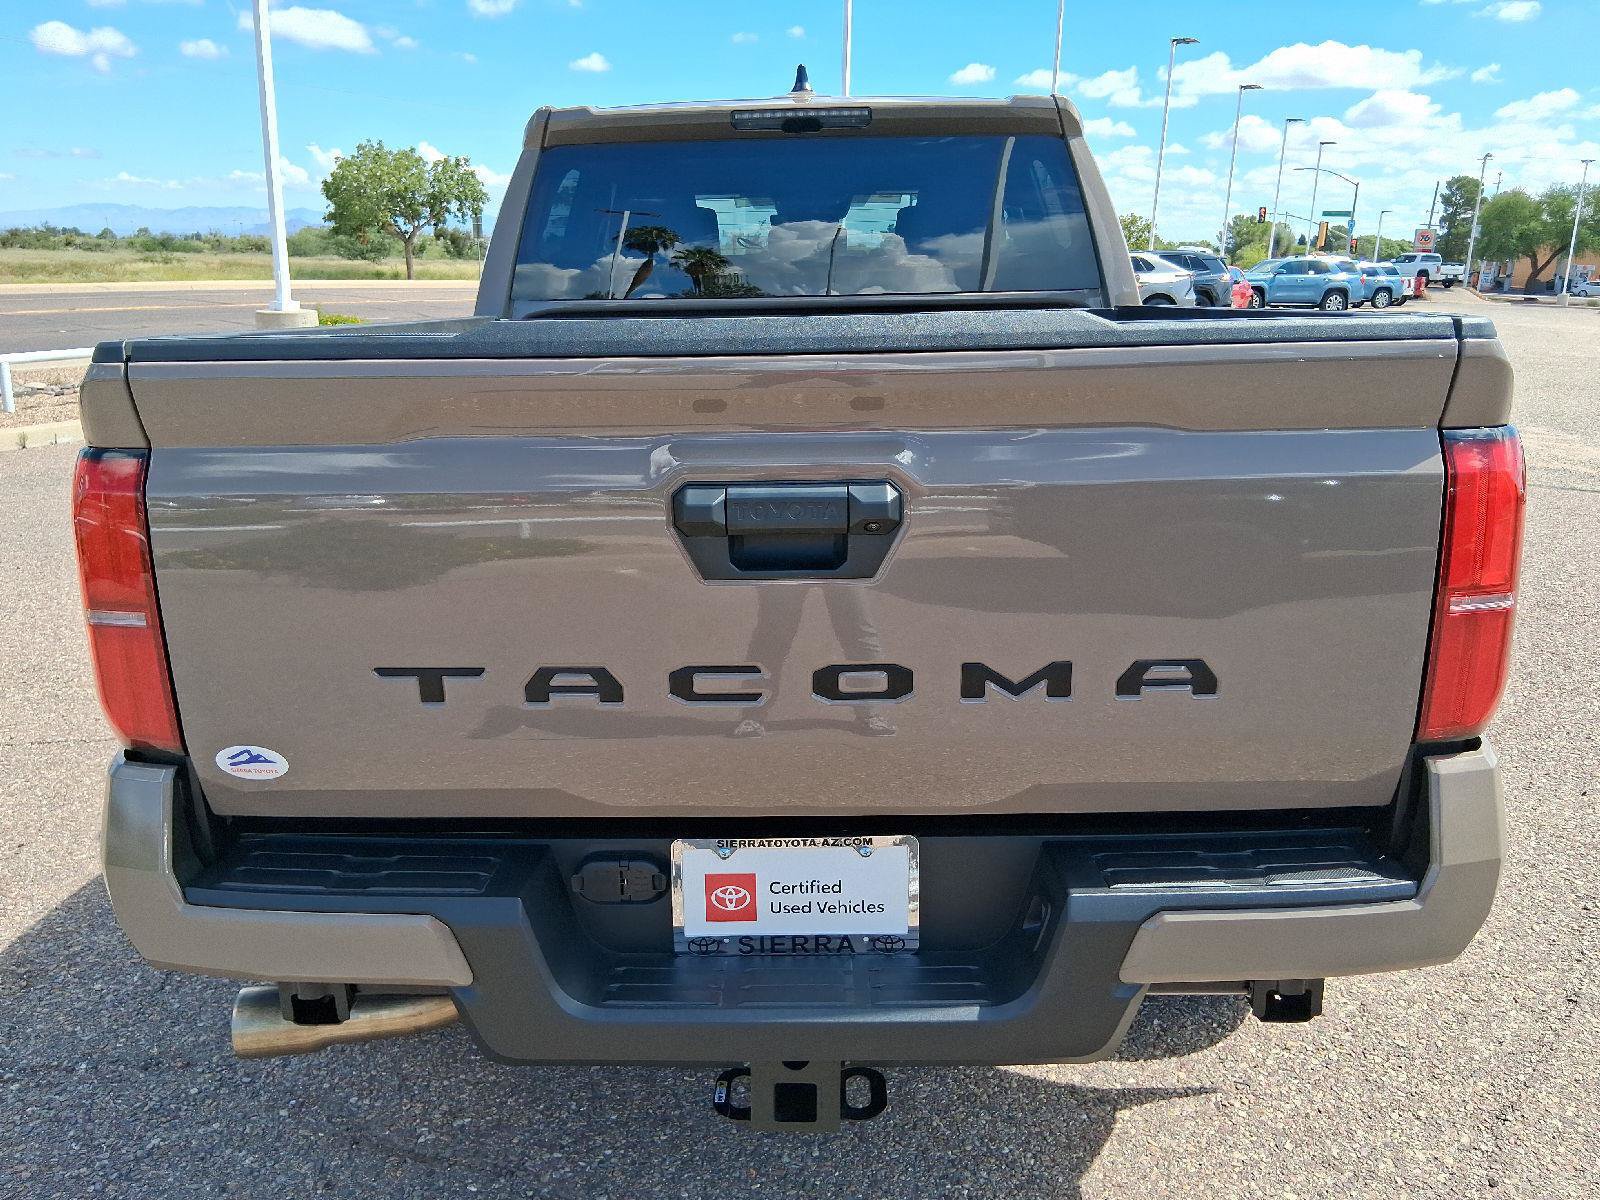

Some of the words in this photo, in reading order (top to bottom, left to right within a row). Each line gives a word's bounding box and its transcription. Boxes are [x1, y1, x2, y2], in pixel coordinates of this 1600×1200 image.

[1419, 234, 1431, 242] 76
[732, 502, 839, 521] TOYOTA
[373, 659, 1218, 704] TACOMA
[716, 837, 873, 849] SIERRATOYOTA-AZ.COM
[769, 880, 842, 895] Certified
[770, 901, 812, 914] Used
[817, 900, 885, 914] Vehicles
[738, 935, 856, 955] SIERRA
